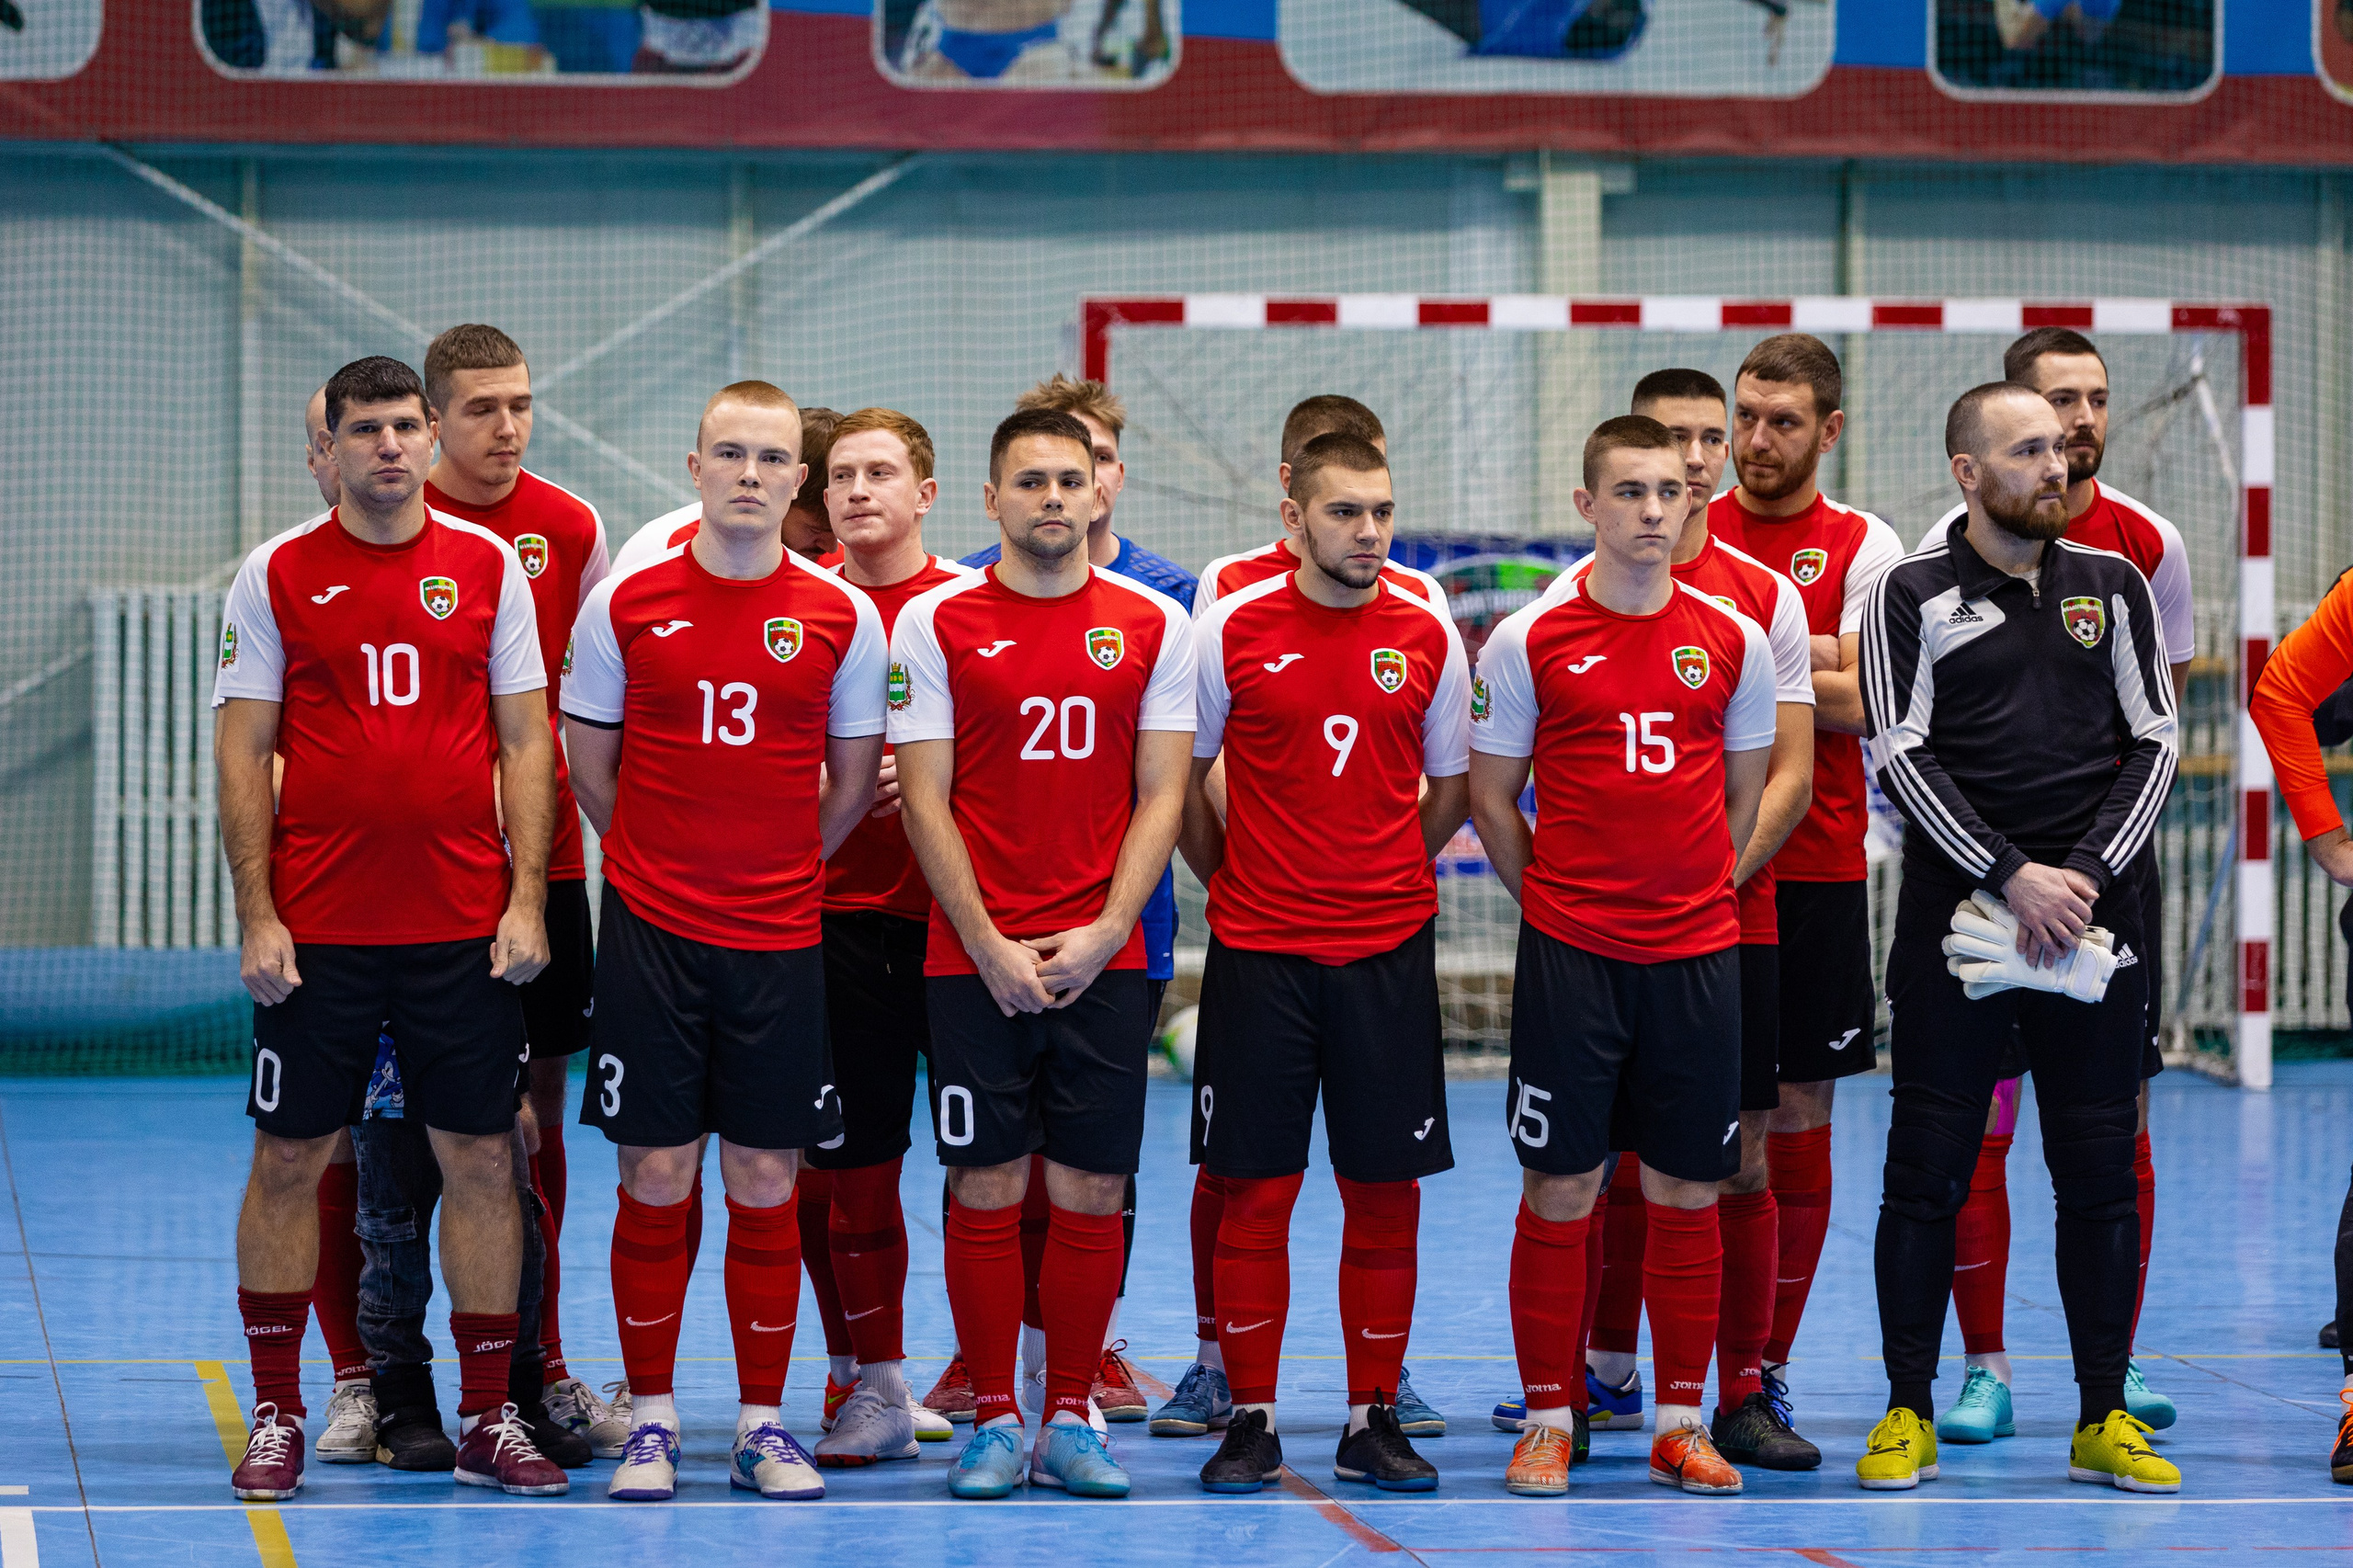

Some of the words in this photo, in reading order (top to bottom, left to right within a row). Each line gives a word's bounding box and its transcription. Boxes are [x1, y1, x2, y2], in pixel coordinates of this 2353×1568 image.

[1949, 615, 1984, 624] adidas
[360, 642, 420, 707] 10
[697, 679, 758, 746] 13
[1019, 696, 1096, 760] 20
[1619, 711, 1676, 774] 15
[1324, 714, 1358, 778] 9
[255, 1038, 282, 1112] 0
[934, 1079, 974, 1146] 0
[1510, 1076, 1552, 1148] 15
[976, 1393, 1011, 1404] Joma
[1525, 1383, 1562, 1393] Joma
